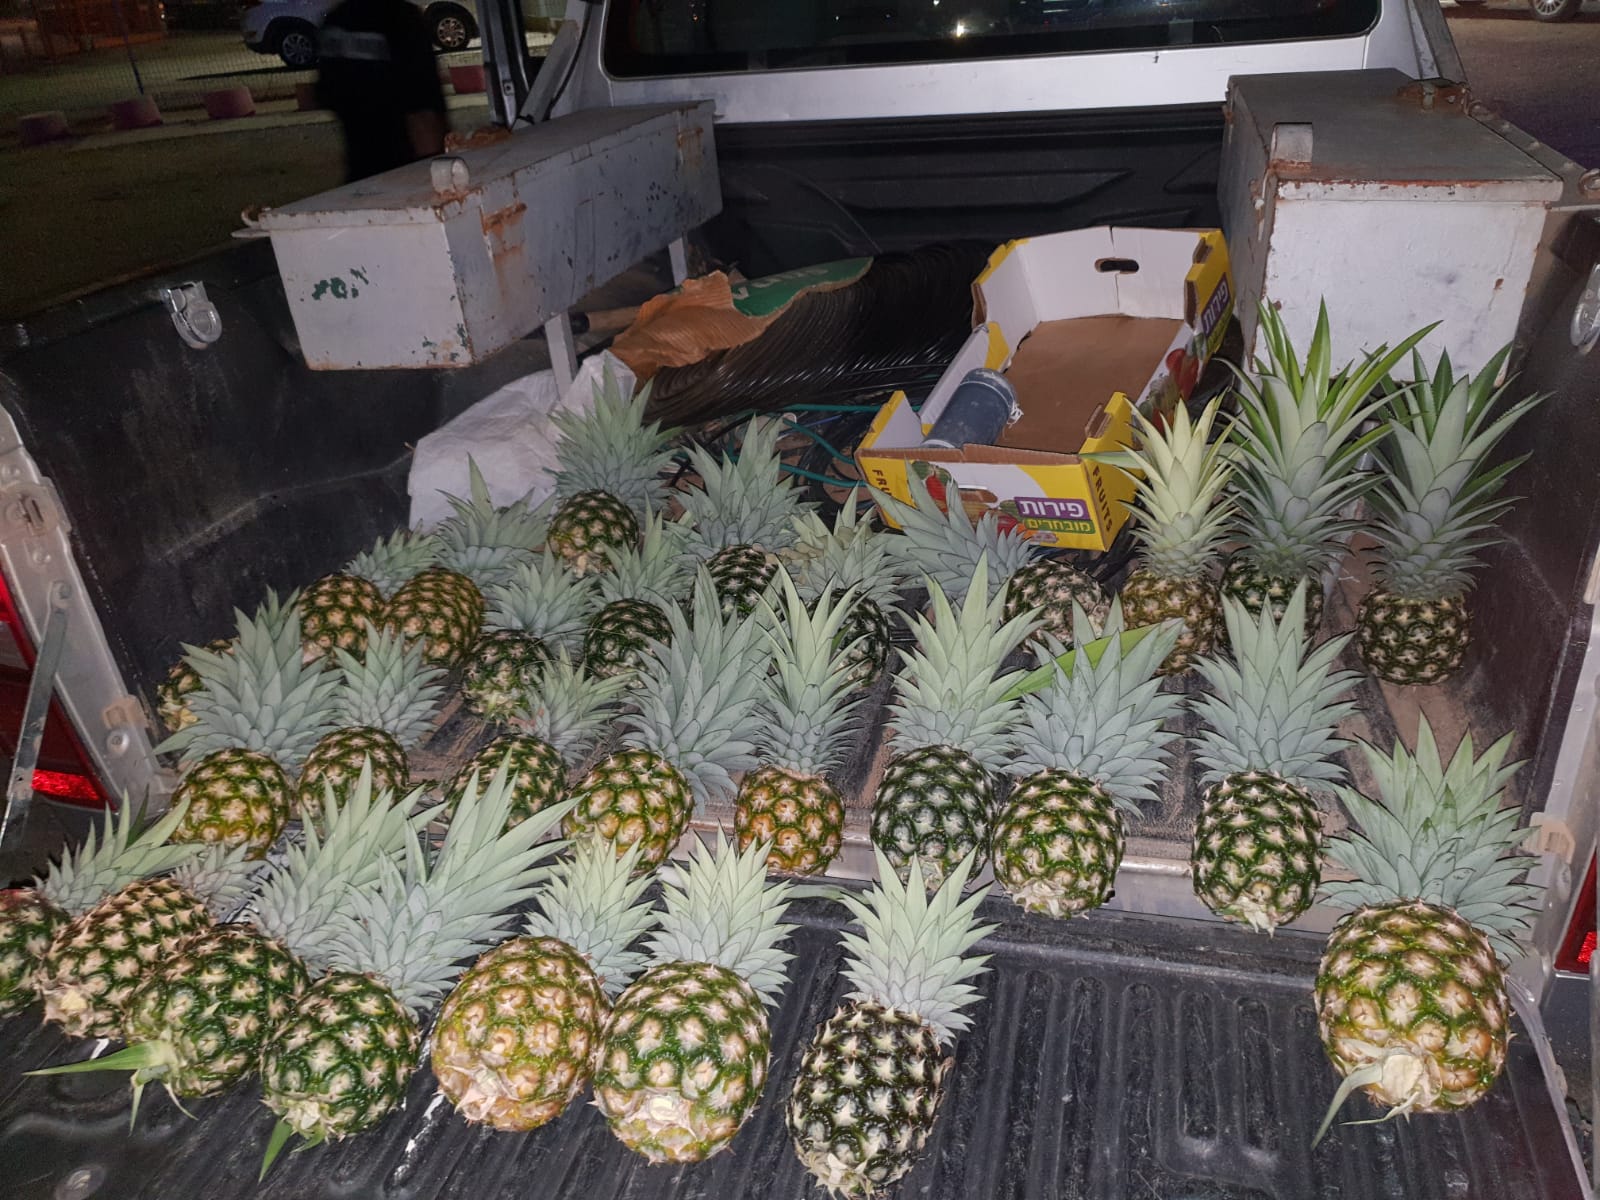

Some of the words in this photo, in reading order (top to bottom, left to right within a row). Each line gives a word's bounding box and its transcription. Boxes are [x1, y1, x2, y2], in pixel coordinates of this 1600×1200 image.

[872, 470, 892, 496] FRU
[1093, 465, 1113, 531] FRUITS
[1020, 501, 1084, 517] פירות
[1028, 519, 1091, 531] מובחרים
